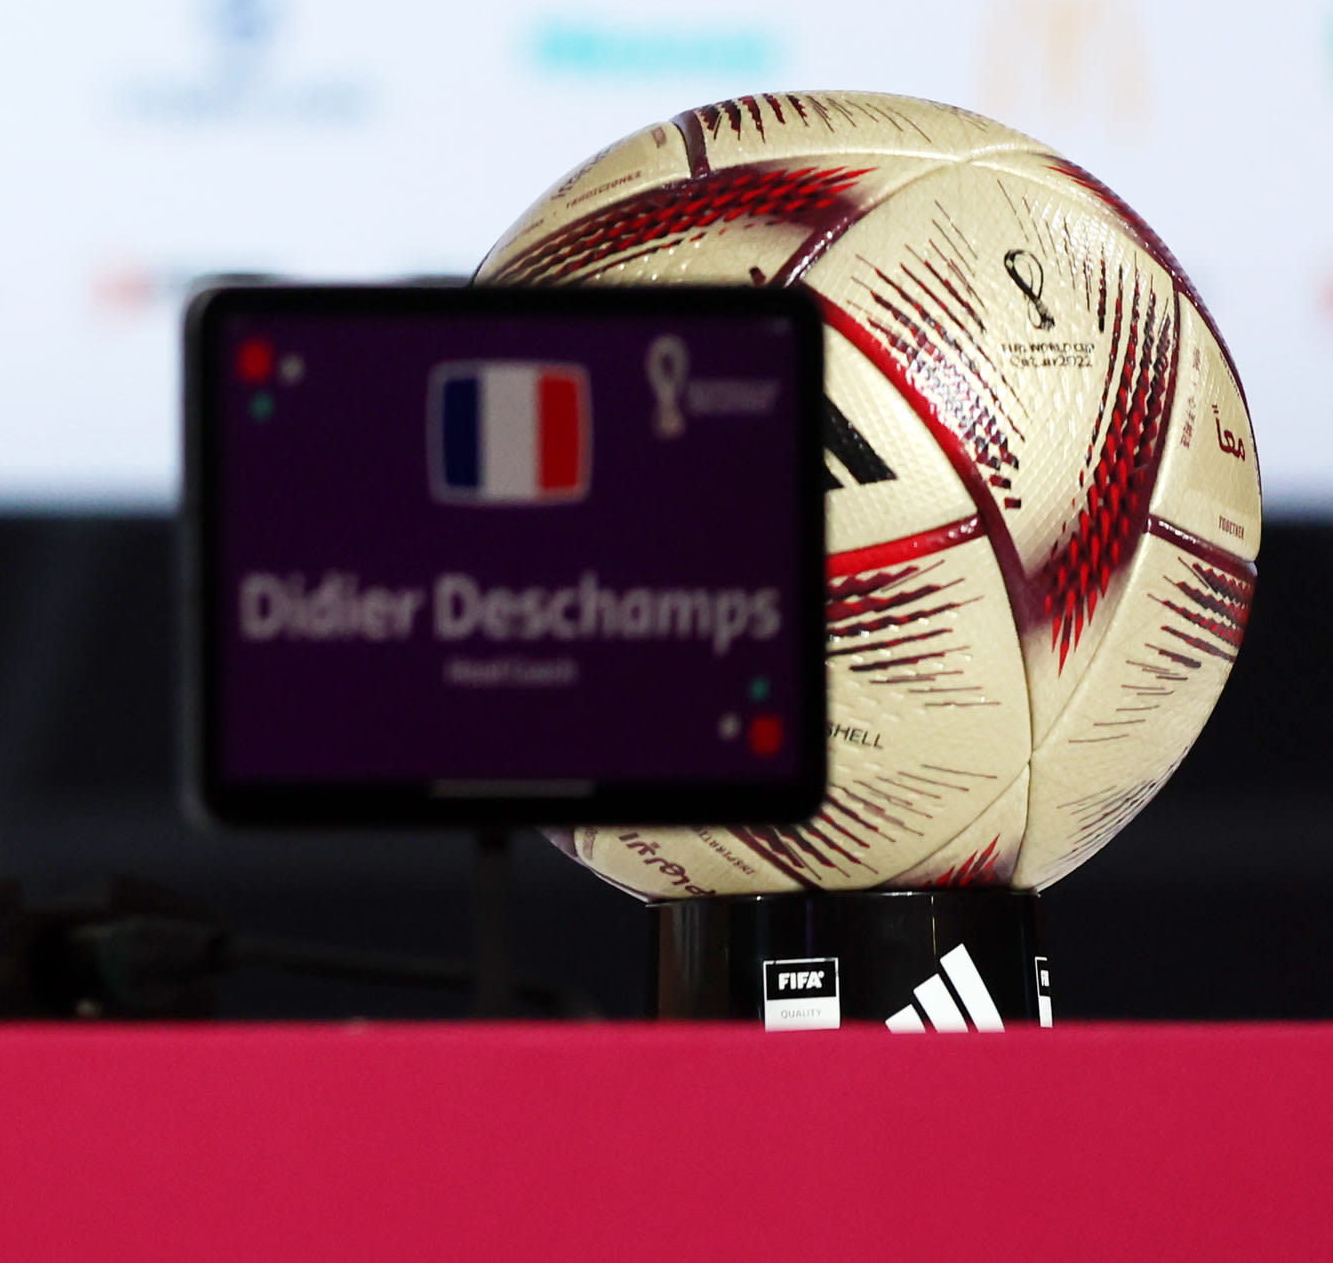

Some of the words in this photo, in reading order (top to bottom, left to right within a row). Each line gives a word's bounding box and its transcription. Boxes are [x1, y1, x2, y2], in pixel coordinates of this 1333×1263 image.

[239, 572, 426, 640] Didier
[434, 570, 782, 657] Deschamps
[778, 970, 823, 991] FIFA
[780, 1009, 822, 1019] QUALITY
